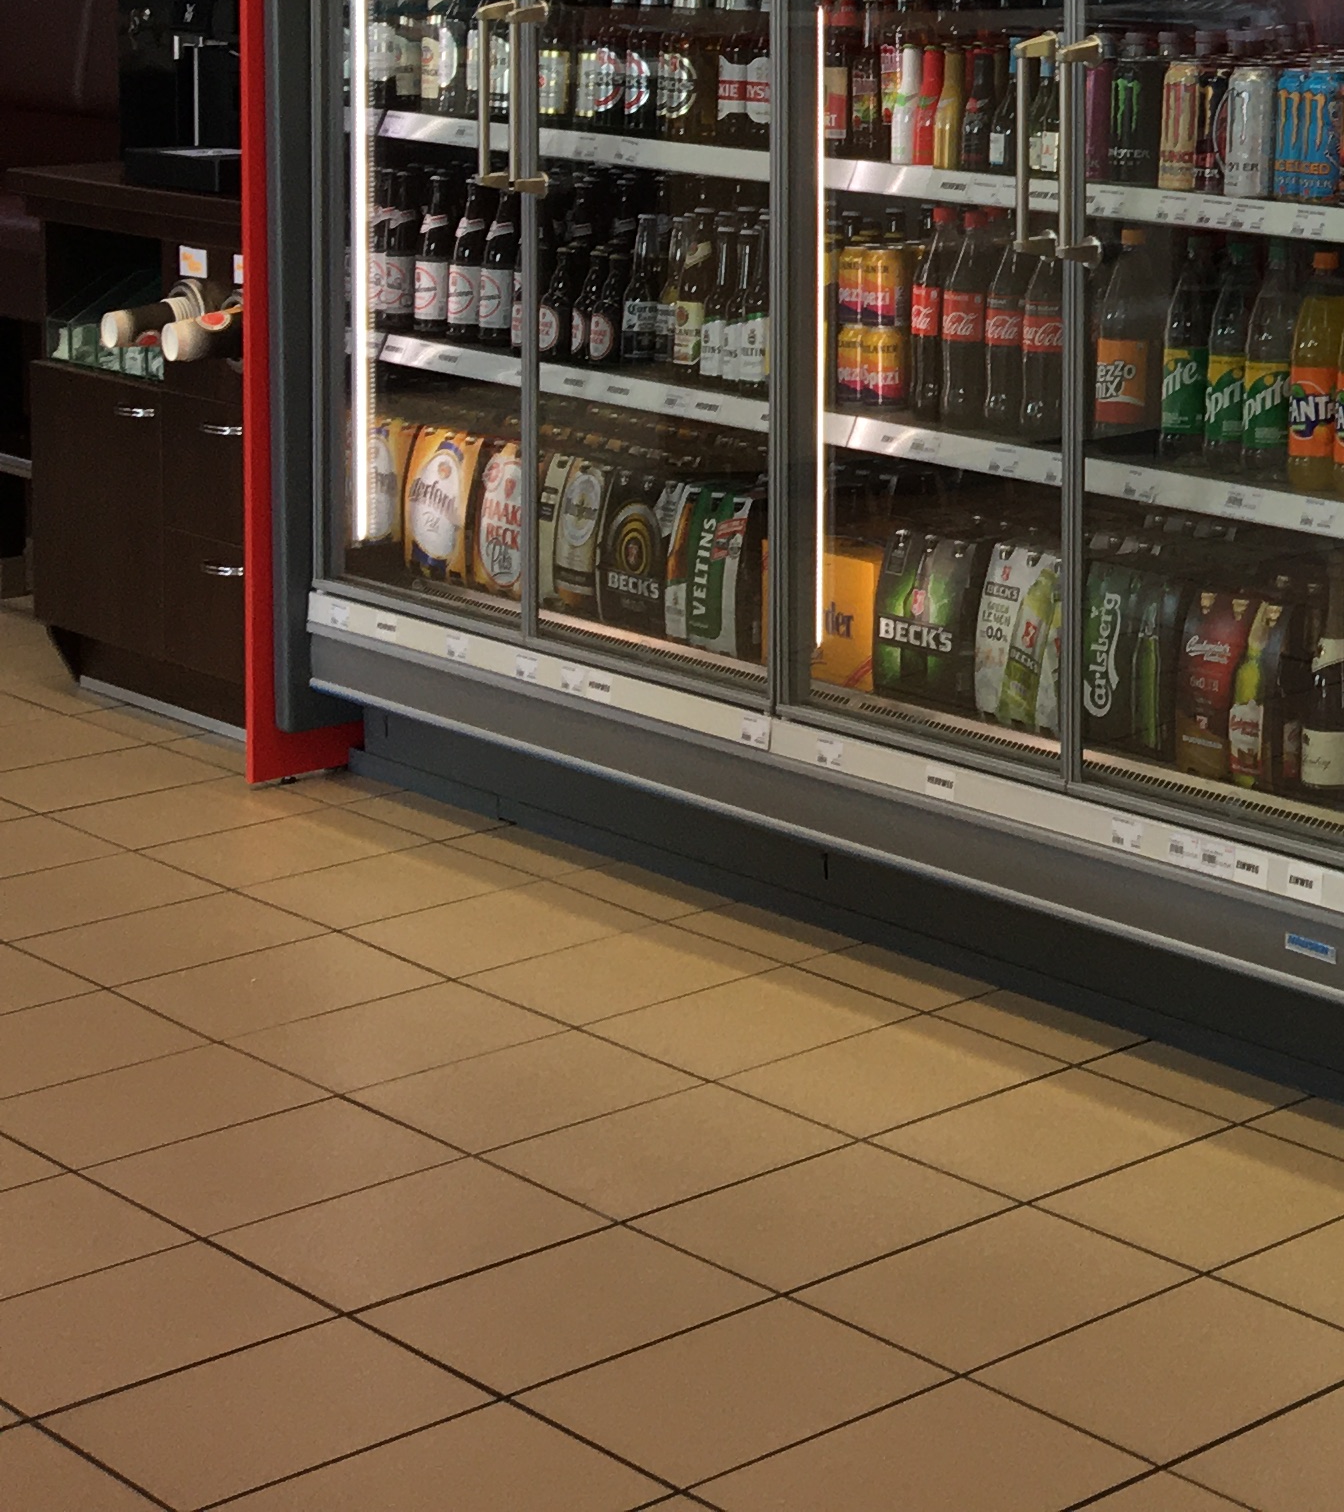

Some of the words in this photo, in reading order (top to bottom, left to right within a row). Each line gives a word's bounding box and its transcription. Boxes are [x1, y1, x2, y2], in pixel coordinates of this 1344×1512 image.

[1096, 362, 1135, 382] ezzo
[692, 518, 717, 616] VELTINS
[608, 571, 659, 600] BECK'S
[985, 583, 1020, 601] BECK'S
[879, 617, 953, 653] BECK'S
[1084, 592, 1121, 717] Carlsberg
[1235, 859, 1260, 875] EINWEG
[1289, 874, 1313, 890] EINWEG
